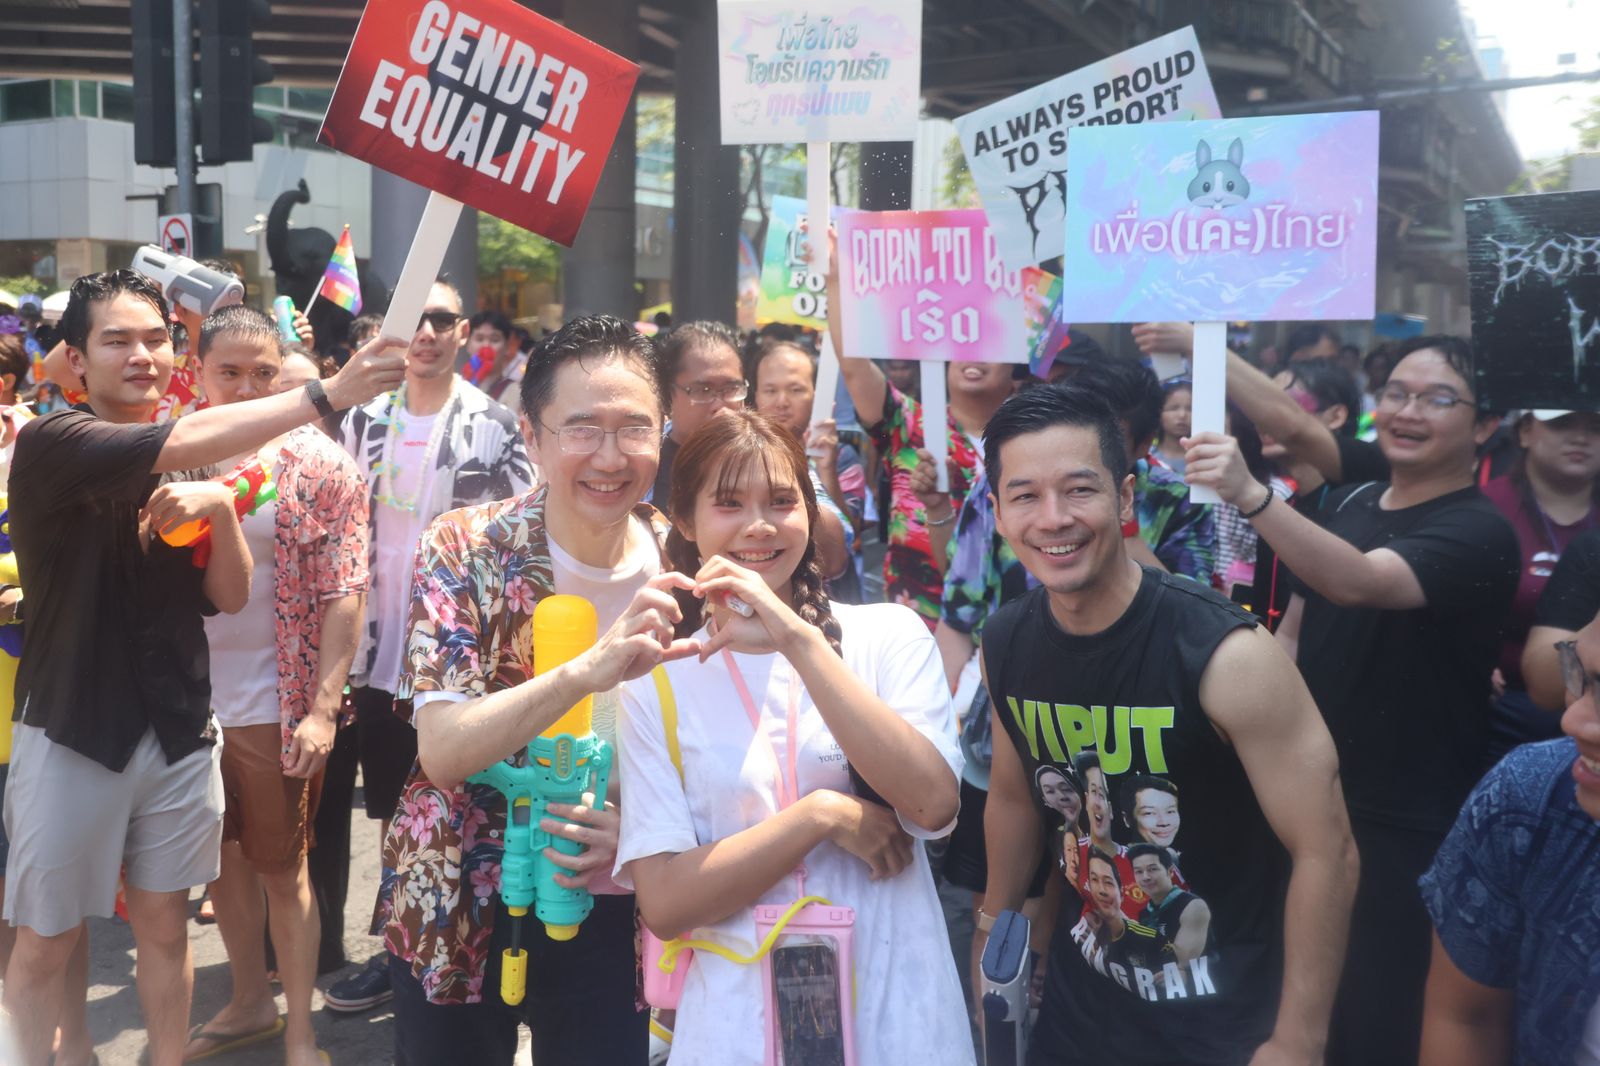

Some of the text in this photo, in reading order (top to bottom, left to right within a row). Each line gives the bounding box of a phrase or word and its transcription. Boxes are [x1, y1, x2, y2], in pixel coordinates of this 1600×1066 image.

[409, 0, 588, 133] GENDER
[744, 51, 892, 84] โอบรับความรัก
[776, 10, 859, 51] เพื่อไทย
[359, 58, 586, 205] EQUALITY
[974, 50, 1195, 157] ALWAYS PROUD
[1002, 84, 1183, 173] TO SPORT
[1093, 199, 1346, 257] เพื่อ(เคะ)ไทย
[1006, 695, 1175, 775] VIPUT
